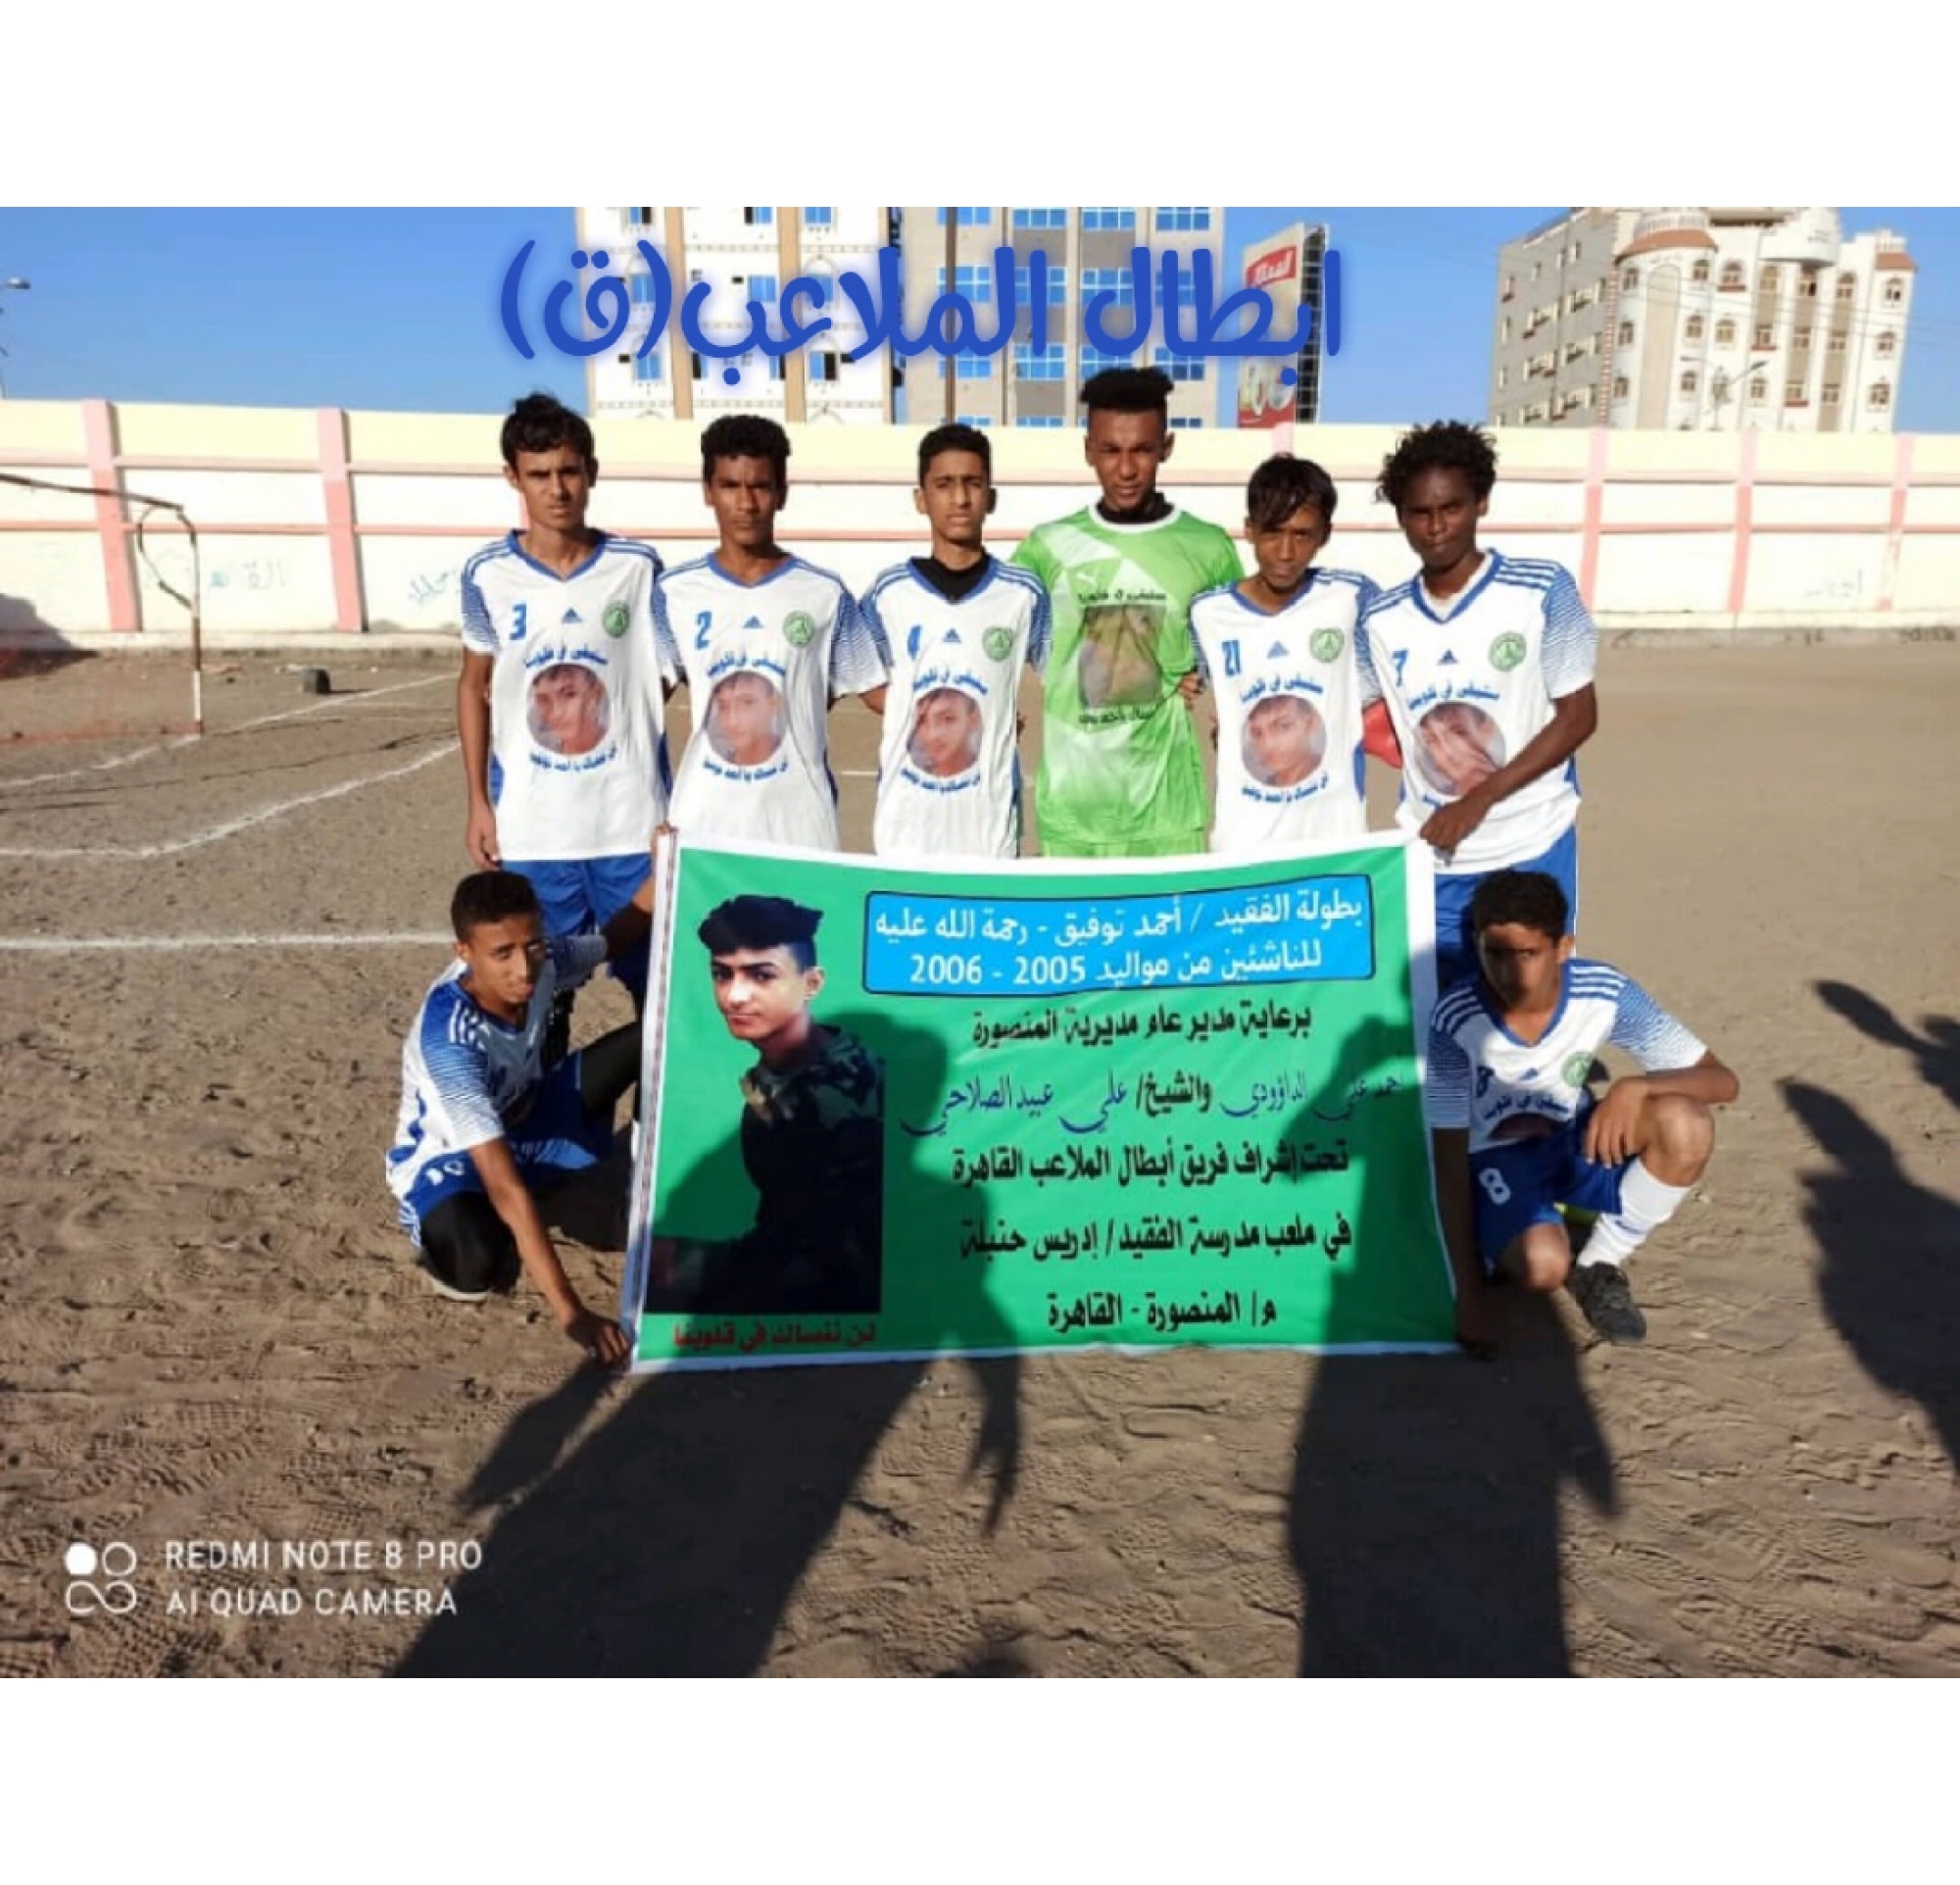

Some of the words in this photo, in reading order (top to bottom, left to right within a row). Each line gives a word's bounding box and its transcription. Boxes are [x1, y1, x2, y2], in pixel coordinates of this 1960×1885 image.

[509, 603, 527, 640] 3
[695, 611, 712, 651] 2
[1393, 649, 1408, 686] 7
[875, 906, 927, 944] عليه
[935, 907, 975, 938] الله
[981, 906, 1028, 945] رحمة
[1054, 907, 1124, 947] توفيق
[1134, 893, 1182, 936] أحمد
[1214, 892, 1290, 934] الفقيد
[1296, 887, 1362, 930] بطولة
[910, 953, 983, 985] 2006
[1013, 955, 1086, 985] 2005
[1097, 949, 1170, 987] مواليد
[1177, 951, 1212, 981] من
[1221, 937, 1322, 981] للناشئين
[972, 1008, 1058, 1048] المنصورة
[1063, 1006, 1139, 1047] مديرية
[1145, 1003, 1182, 1040] عام
[1186, 1007, 1236, 1042] مدير
[1239, 998, 1312, 1039] برعاية
[898, 1072, 1013, 1138] الصلاحي
[1058, 1067, 1128, 1135] علي
[952, 1145, 1023, 1190] القاهرة
[1030, 1143, 1111, 1188] الملاعب
[1118, 1135, 1175, 1188] أبطال
[1180, 1139, 1229, 1187] فريق
[1300, 1137, 1349, 1171] تحت
[1478, 1166, 1511, 1206] 8
[1033, 1218, 1099, 1262] إدريس
[1189, 1214, 1260, 1259] مدرسة
[1264, 1210, 1316, 1257] ملعب
[1323, 1210, 1351, 1262] في
[1047, 1291, 1123, 1334] القاهرة
[1145, 1289, 1241, 1333] المنصورة
